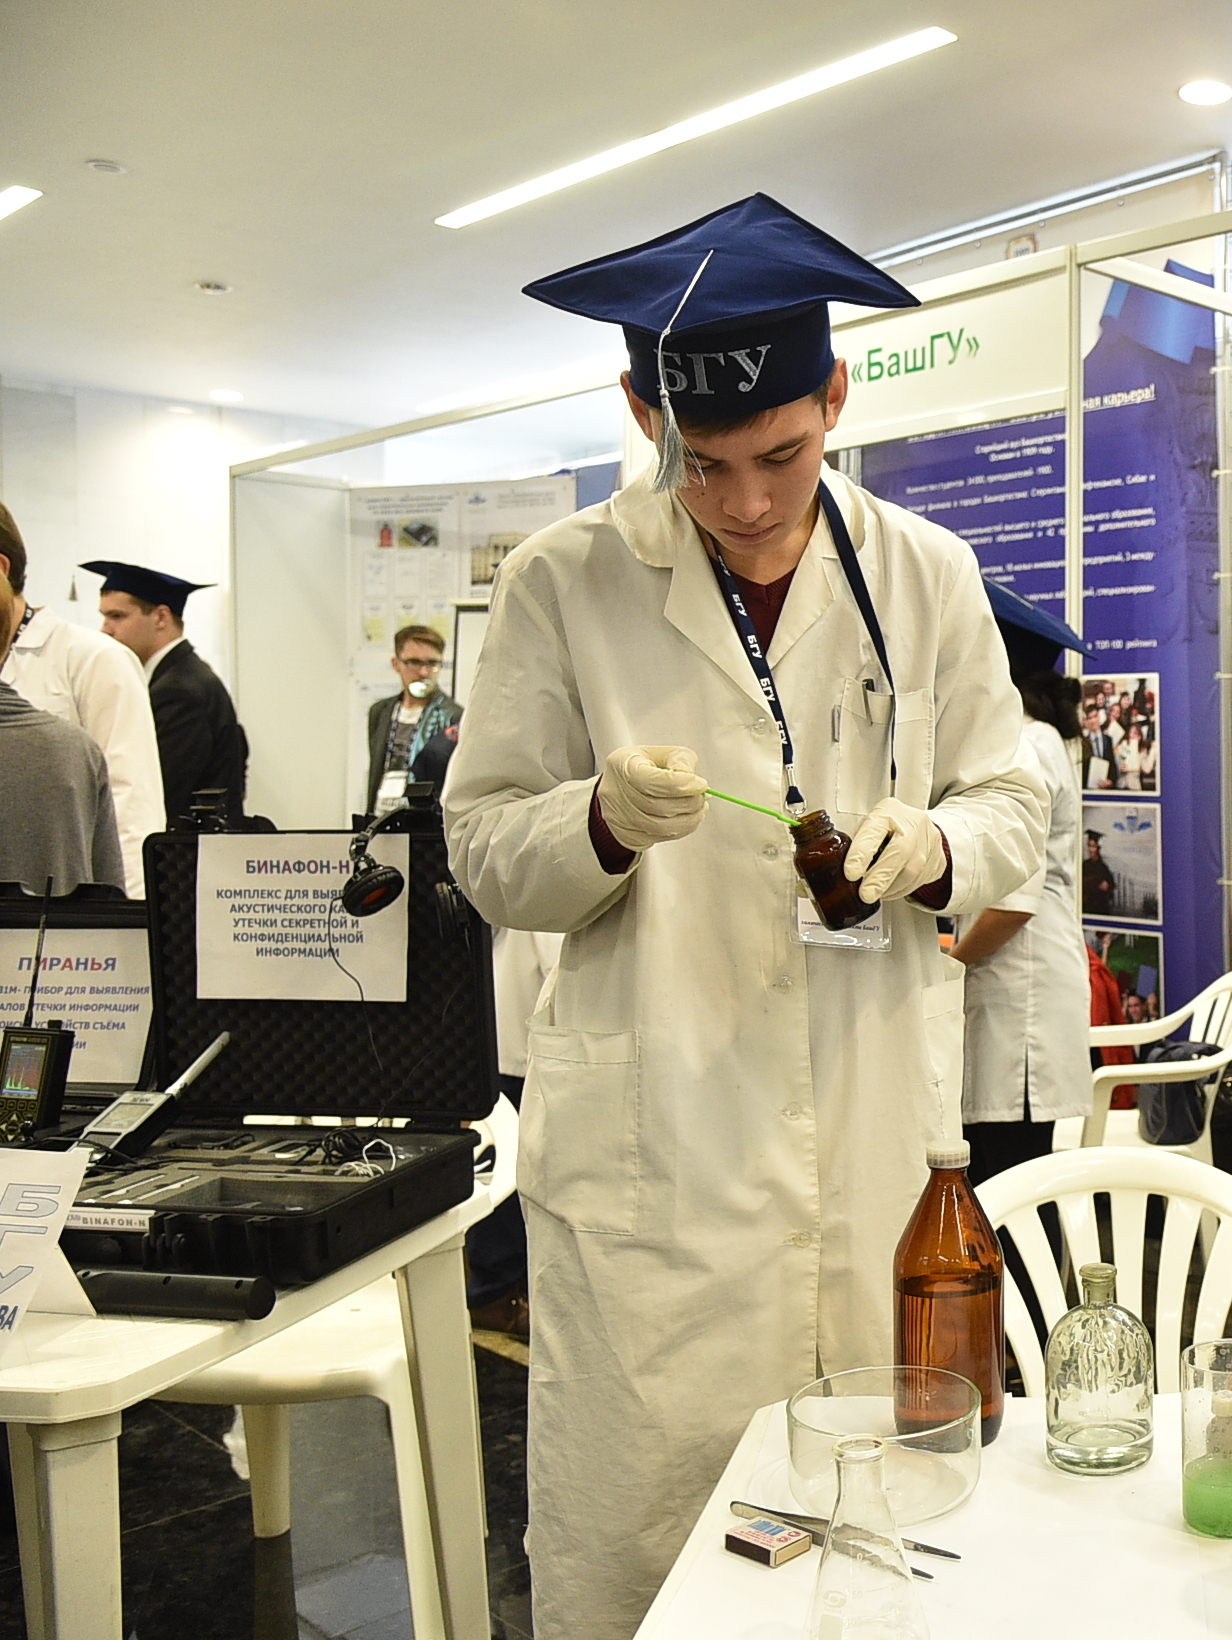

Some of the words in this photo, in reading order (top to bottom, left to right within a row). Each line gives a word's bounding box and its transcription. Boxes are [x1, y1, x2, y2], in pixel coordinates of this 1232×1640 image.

[850, 327, 981, 384] «БашГУ»
[653, 344, 772, 395] БГУ
[731, 593, 748, 617] БГУ
[746, 634, 763, 659] БГУ
[760, 677, 776, 702] БГУ
[245, 859, 350, 874] БИНАФОН-Н
[216, 889, 282, 900] КОМПЛЕКС
[284, 889, 309, 901] ДЛЯ
[229, 903, 327, 914] АКУСТИЧЕСКОГО
[233, 918, 278, 929] УТЕЧКИ
[280, 916, 348, 929] СЕКРЕТНОЙ
[351, 918, 360, 929] И
[233, 931, 364, 944] КОНФИДЕНЦИАЛЬНОЙ
[256, 947, 340, 959] ИНФОРМАЦИИ
[23, 985, 63, 995] ПИБОР
[65, 986, 86, 996] ДЛЯ
[88, 986, 150, 995] ВЫЯВЛЕНИЯ
[33, 1003, 66, 1012] ТЕЧКИ
[68, 1003, 140, 1013] ИНФОРМАЦИИ
[92, 1020, 126, 1030] СЪЁМА
[82, 1214, 146, 1227] BINAFON-N
